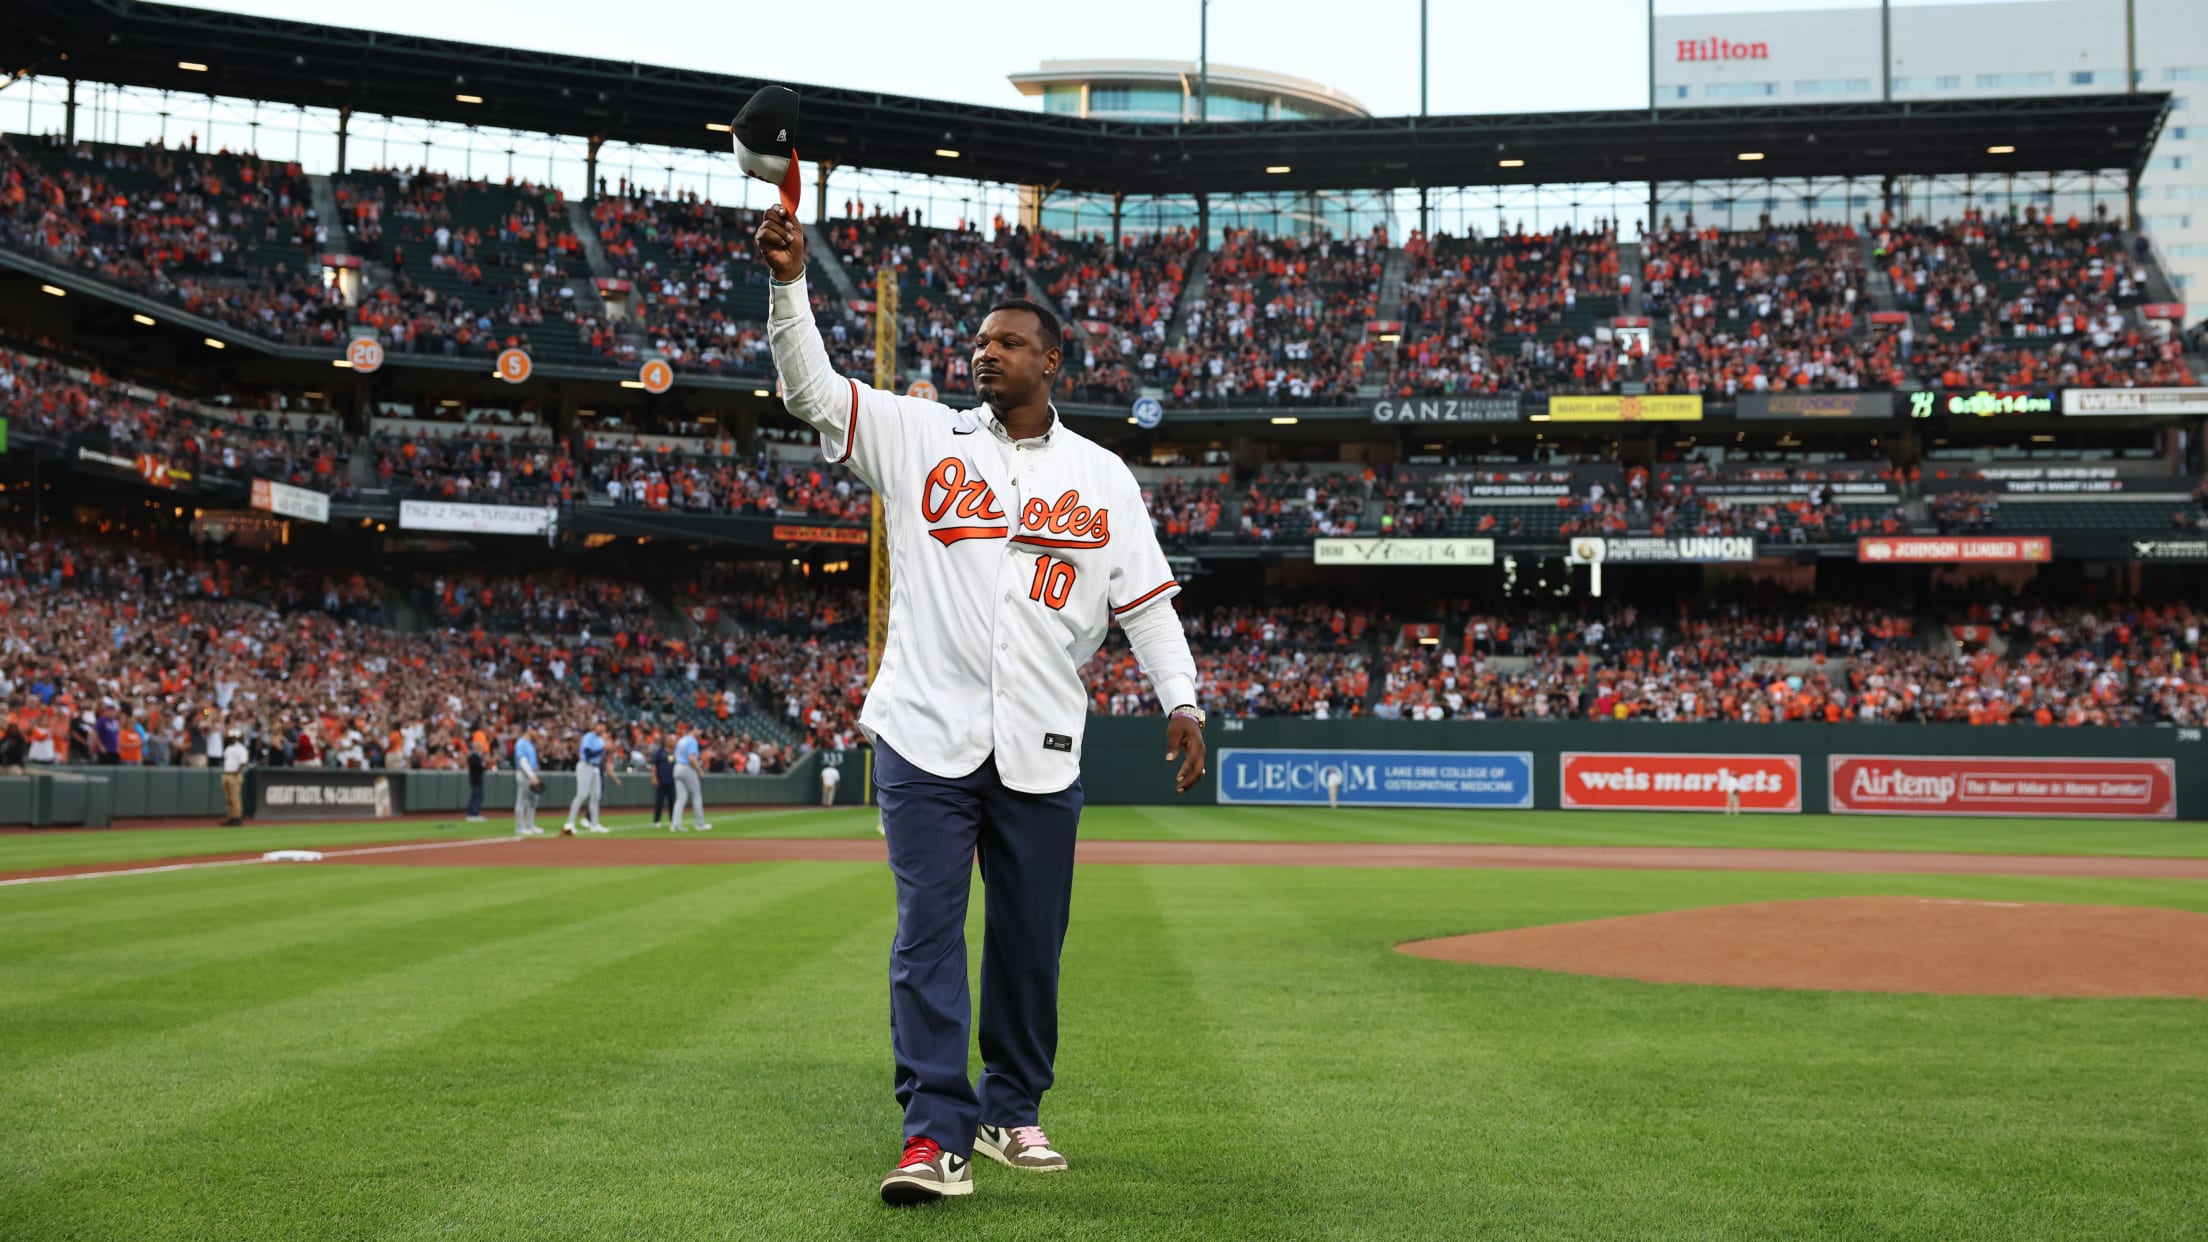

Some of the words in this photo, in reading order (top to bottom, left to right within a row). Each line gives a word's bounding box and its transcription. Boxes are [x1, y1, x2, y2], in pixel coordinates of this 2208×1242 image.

[1677, 36, 1768, 61] Hilton
[353, 345, 377, 363] 20
[508, 356, 521, 375] 5
[650, 367, 662, 386] 4
[1138, 403, 1158, 420] 42
[1374, 401, 1459, 421] GANZ
[921, 457, 1111, 540] Orioles
[1473, 485, 1503, 496] PEPSI
[1504, 485, 1532, 496] ZERO
[1533, 485, 1569, 495] SUGAR
[1608, 538, 1666, 549] PLUMBERS
[1680, 537, 1753, 559] UNION
[1896, 541, 1959, 558] JOHNSON
[1961, 541, 2017, 558] LUMBER
[1030, 555, 1076, 611] 10
[1385, 766, 1411, 778] LAKE
[1415, 766, 1437, 778] ERIE
[1440, 766, 1486, 779] COLLEGE
[1489, 767, 1506, 779] OF
[1580, 767, 1650, 790] weis
[1654, 768, 1782, 792] markets
[1385, 779, 1458, 792] OSTEOPATHIC
[1460, 780, 1514, 793] MEDICINE
[1852, 766, 1955, 804] Airtemp
[1967, 780, 1986, 794] The
[266, 785, 295, 805] GREAT
[336, 785, 375, 805] CALORIES
